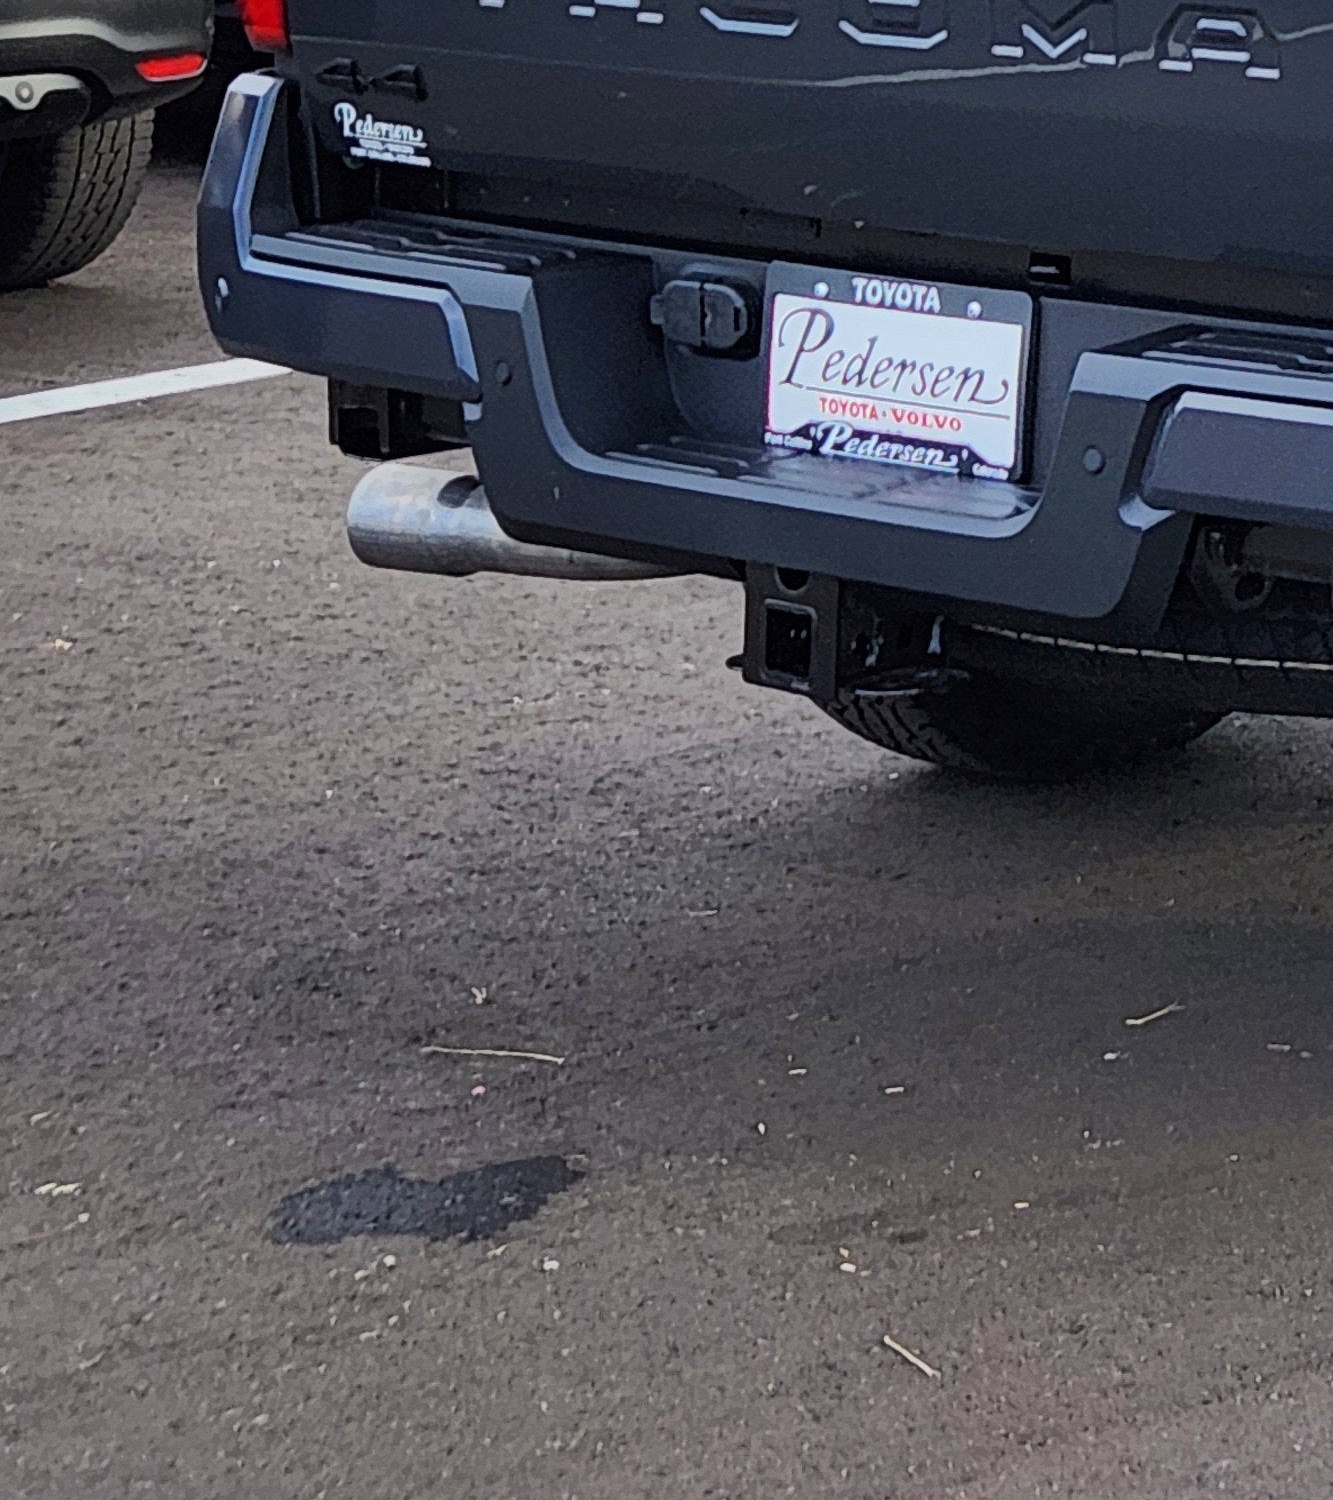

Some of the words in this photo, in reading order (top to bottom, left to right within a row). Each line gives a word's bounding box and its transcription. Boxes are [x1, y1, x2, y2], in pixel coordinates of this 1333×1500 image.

[333, 102, 424, 143] Pedersen
[852, 277, 941, 313] TOYOTA
[778, 308, 1010, 406] Pedersen
[819, 396, 880, 420] TOYOTA
[890, 407, 963, 432] VOLVO
